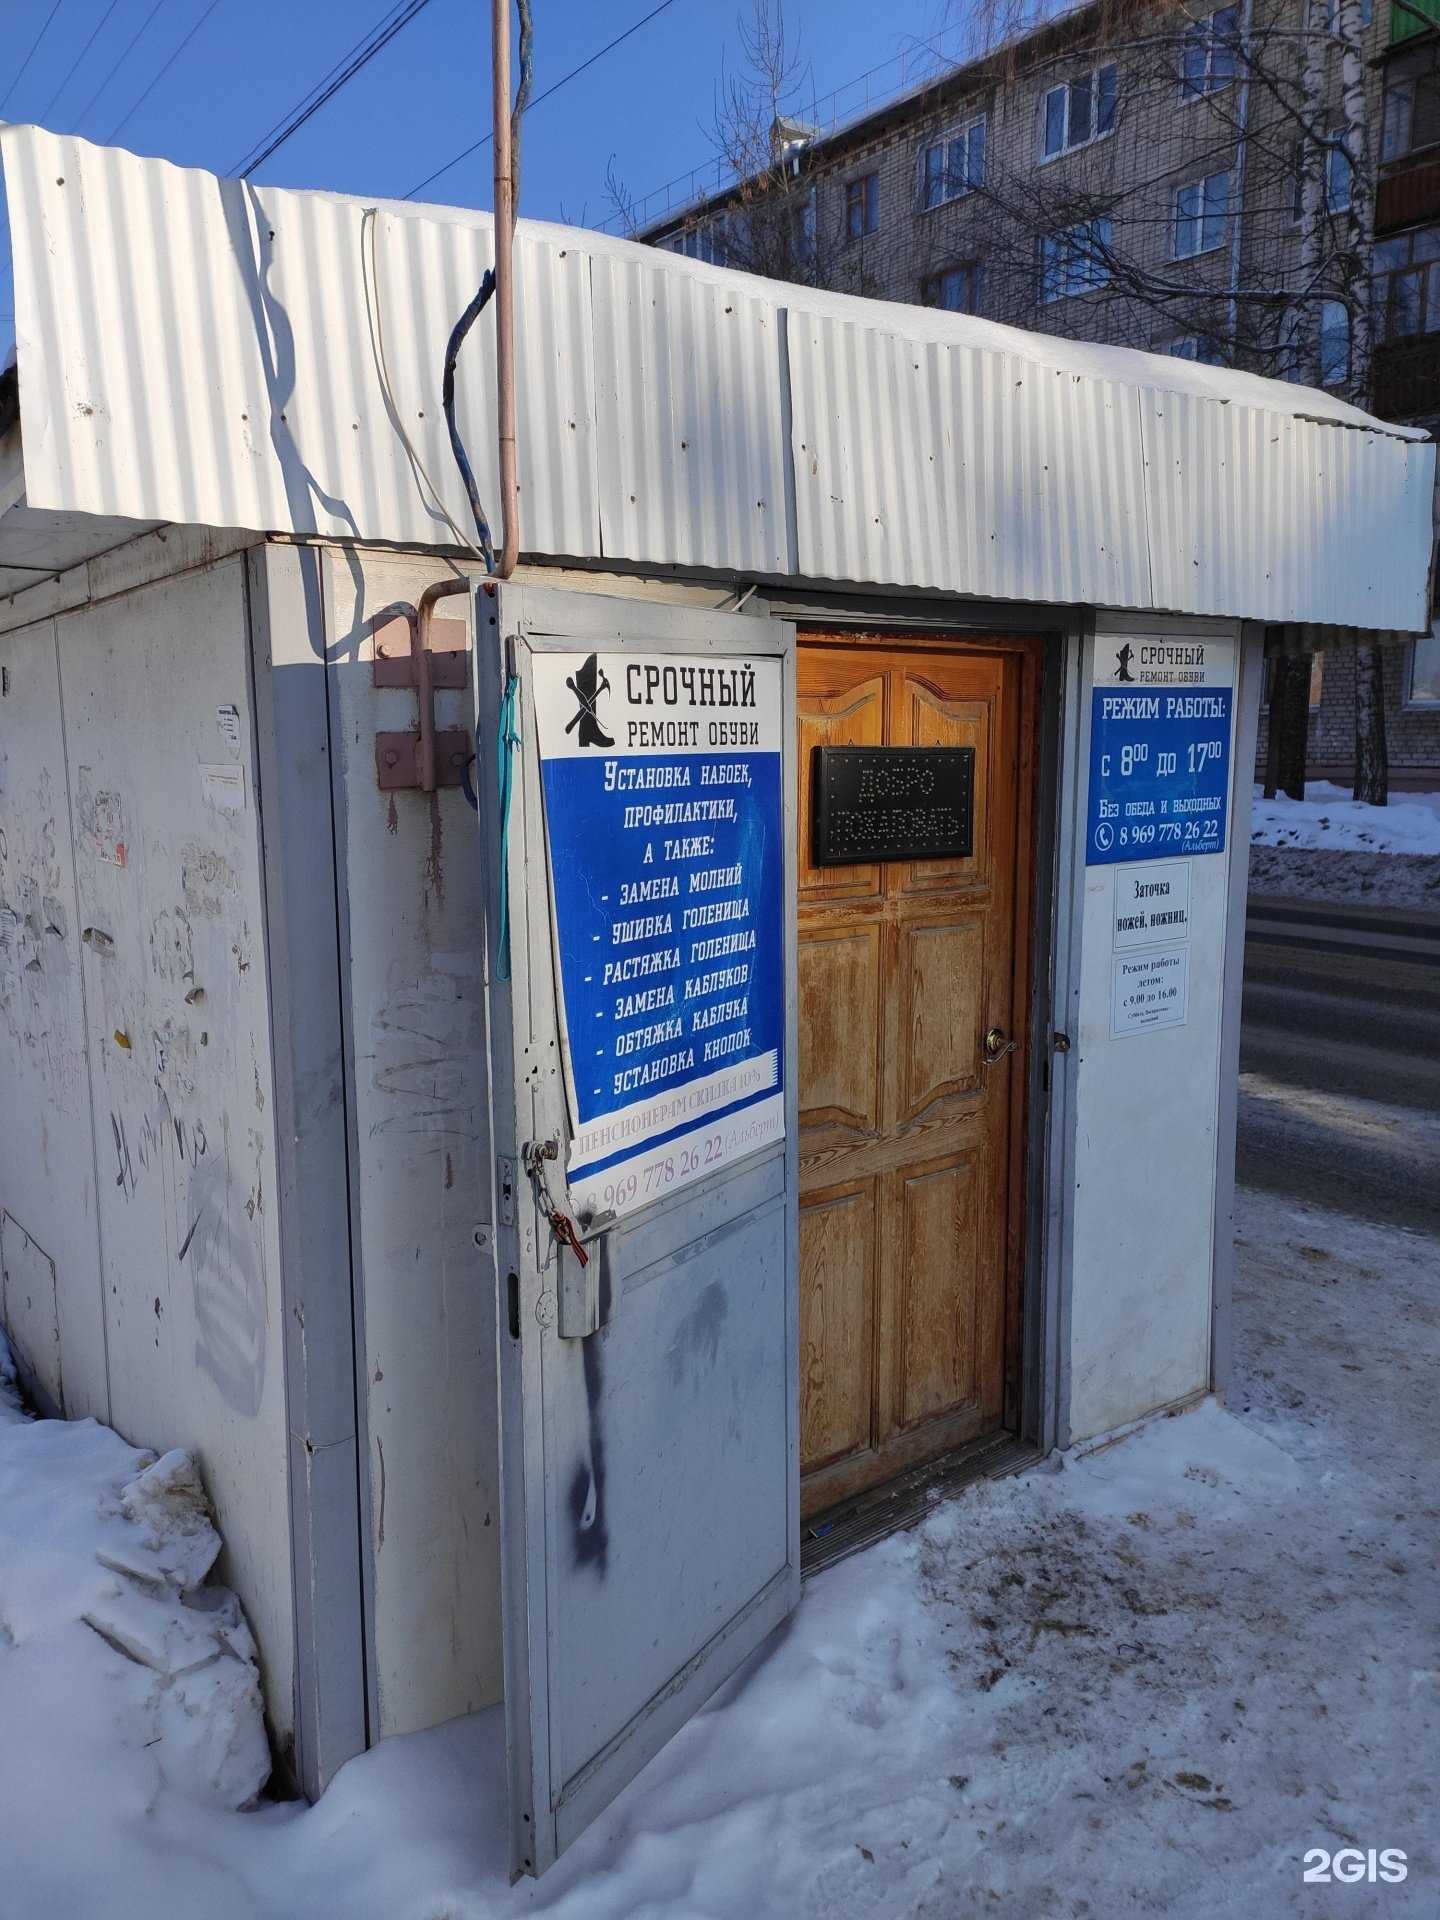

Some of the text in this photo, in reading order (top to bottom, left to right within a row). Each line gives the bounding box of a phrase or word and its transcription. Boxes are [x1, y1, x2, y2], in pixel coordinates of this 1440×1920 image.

[1140, 645, 1205, 666] СРОЧНЫЙ
[626, 663, 757, 707] СРОЧНЫЙ
[1139, 671, 1205, 683] РЕМОНТ ОБУВИ
[1102, 697, 1226, 720] РЕЖИМ РАБОТЫ:
[627, 721, 759, 747] РЕМОНТ ОБУВИ
[623, 798, 738, 829] ПРОФИЛАКТИКИ,
[1119, 819, 1218, 846] 8 969 778 26 22
[643, 837, 715, 864] А ТАКЖЕ:
[619, 862, 743, 906] ЗАМЕНА МОЛНИЙ
[1133, 880, 1170, 899] Заточка
[612, 898, 750, 945] УШИВКА ГОЛЕНИЩА
[1117, 911, 1148, 932] ножей,
[603, 929, 756, 986] РАСТЯЖКА ГОЛЕНИЩА
[1122, 957, 1180, 975] Режим работы
[614, 964, 749, 1020] ЗАМЕНА КАБЛУКОВ
[1136, 976, 1164, 989] летом:
[1129, 993, 1145, 1006] 9.00
[1157, 987, 1177, 1001] 16.00
[615, 996, 748, 1057] ОБТЯЖКА КАБЛУКА
[613, 1028, 751, 1096] УСТАНОВКА КНОПОК
[577, 1093, 688, 1156] ПЕНСИОНЕРАМ
[604, 1177, 638, 1208] 969
[643, 1158, 675, 1194] 778
[680, 1147, 700, 1179] 26
[703, 1135, 723, 1165] 22
